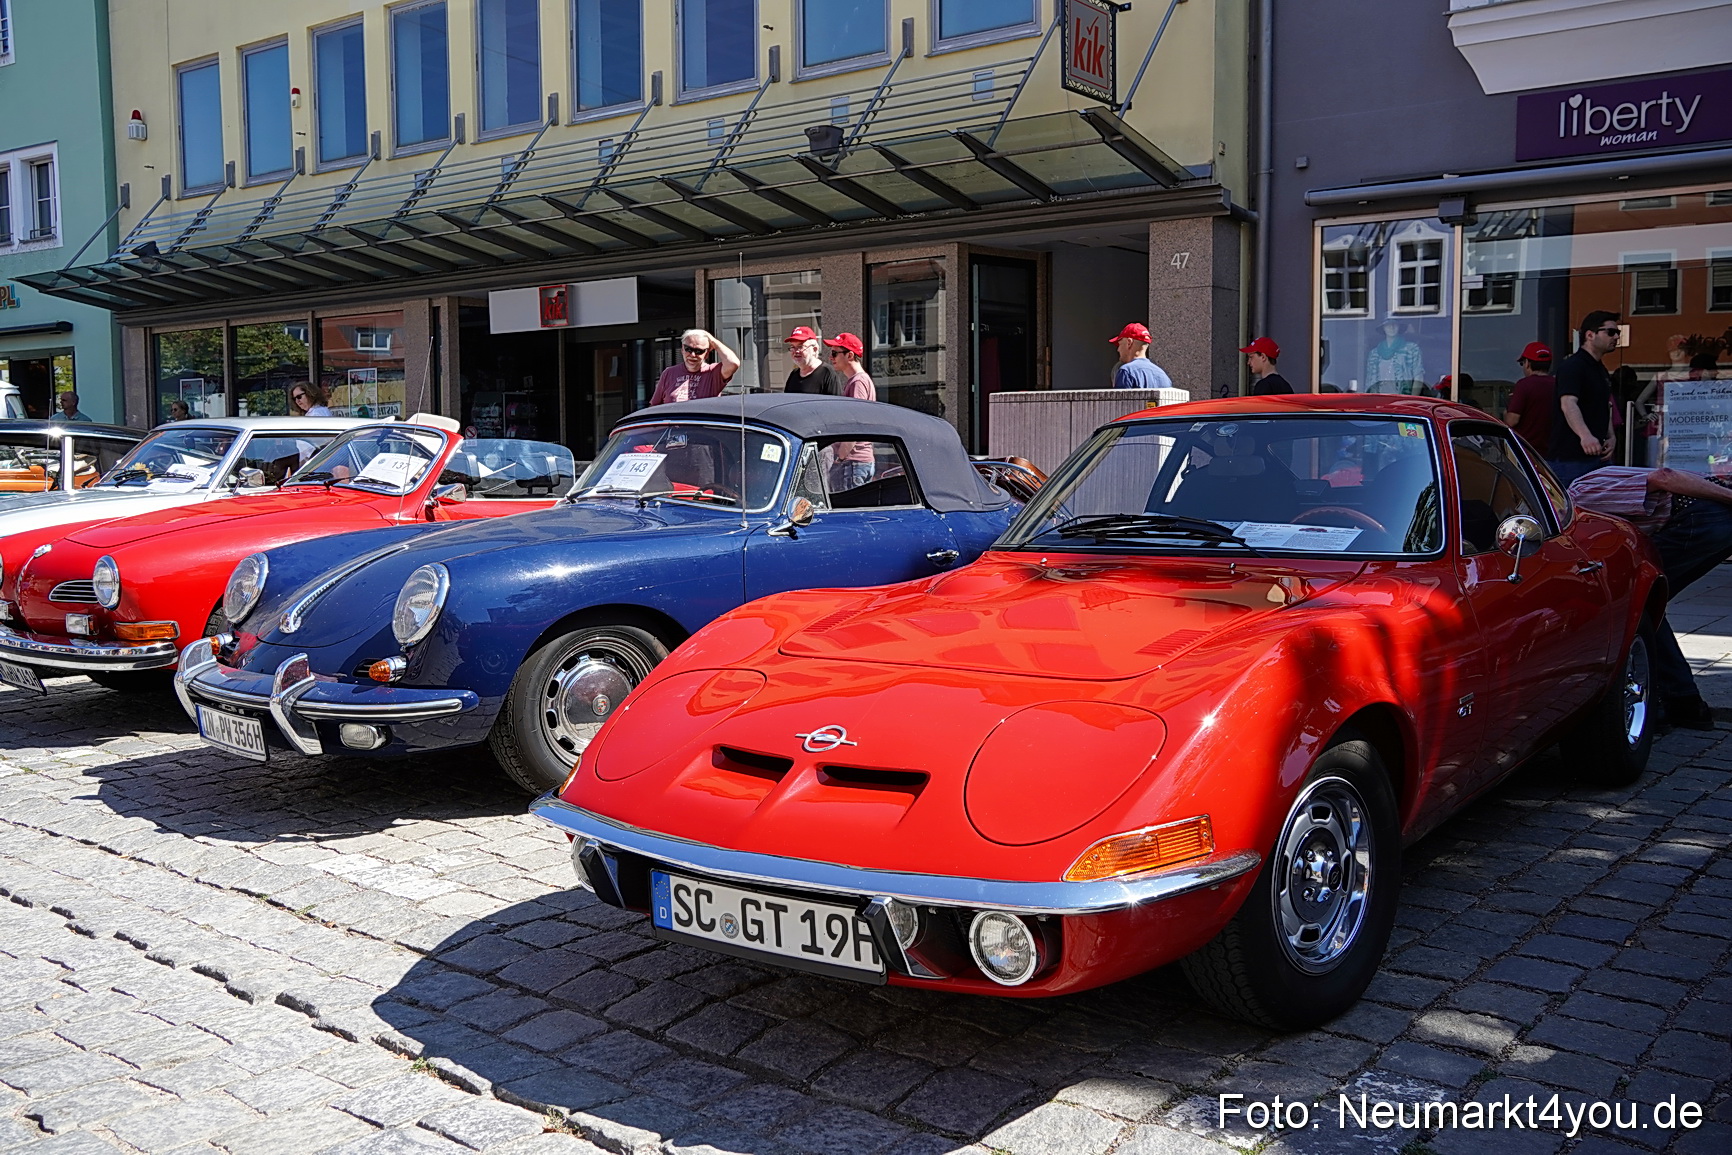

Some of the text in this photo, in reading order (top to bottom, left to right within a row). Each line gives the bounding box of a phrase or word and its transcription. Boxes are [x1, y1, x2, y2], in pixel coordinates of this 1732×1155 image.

[1559, 91, 1701, 138] liberty
[1600, 130, 1657, 146] woman
[1171, 252, 1190, 269] 47
[1669, 415, 1729, 424] MODEBERATER
[392, 461, 410, 470] 137
[629, 462, 648, 473] 143
[232, 719, 264, 751] 356H
[659, 906, 667, 919] D
[673, 883, 880, 965] SC GT 19H
